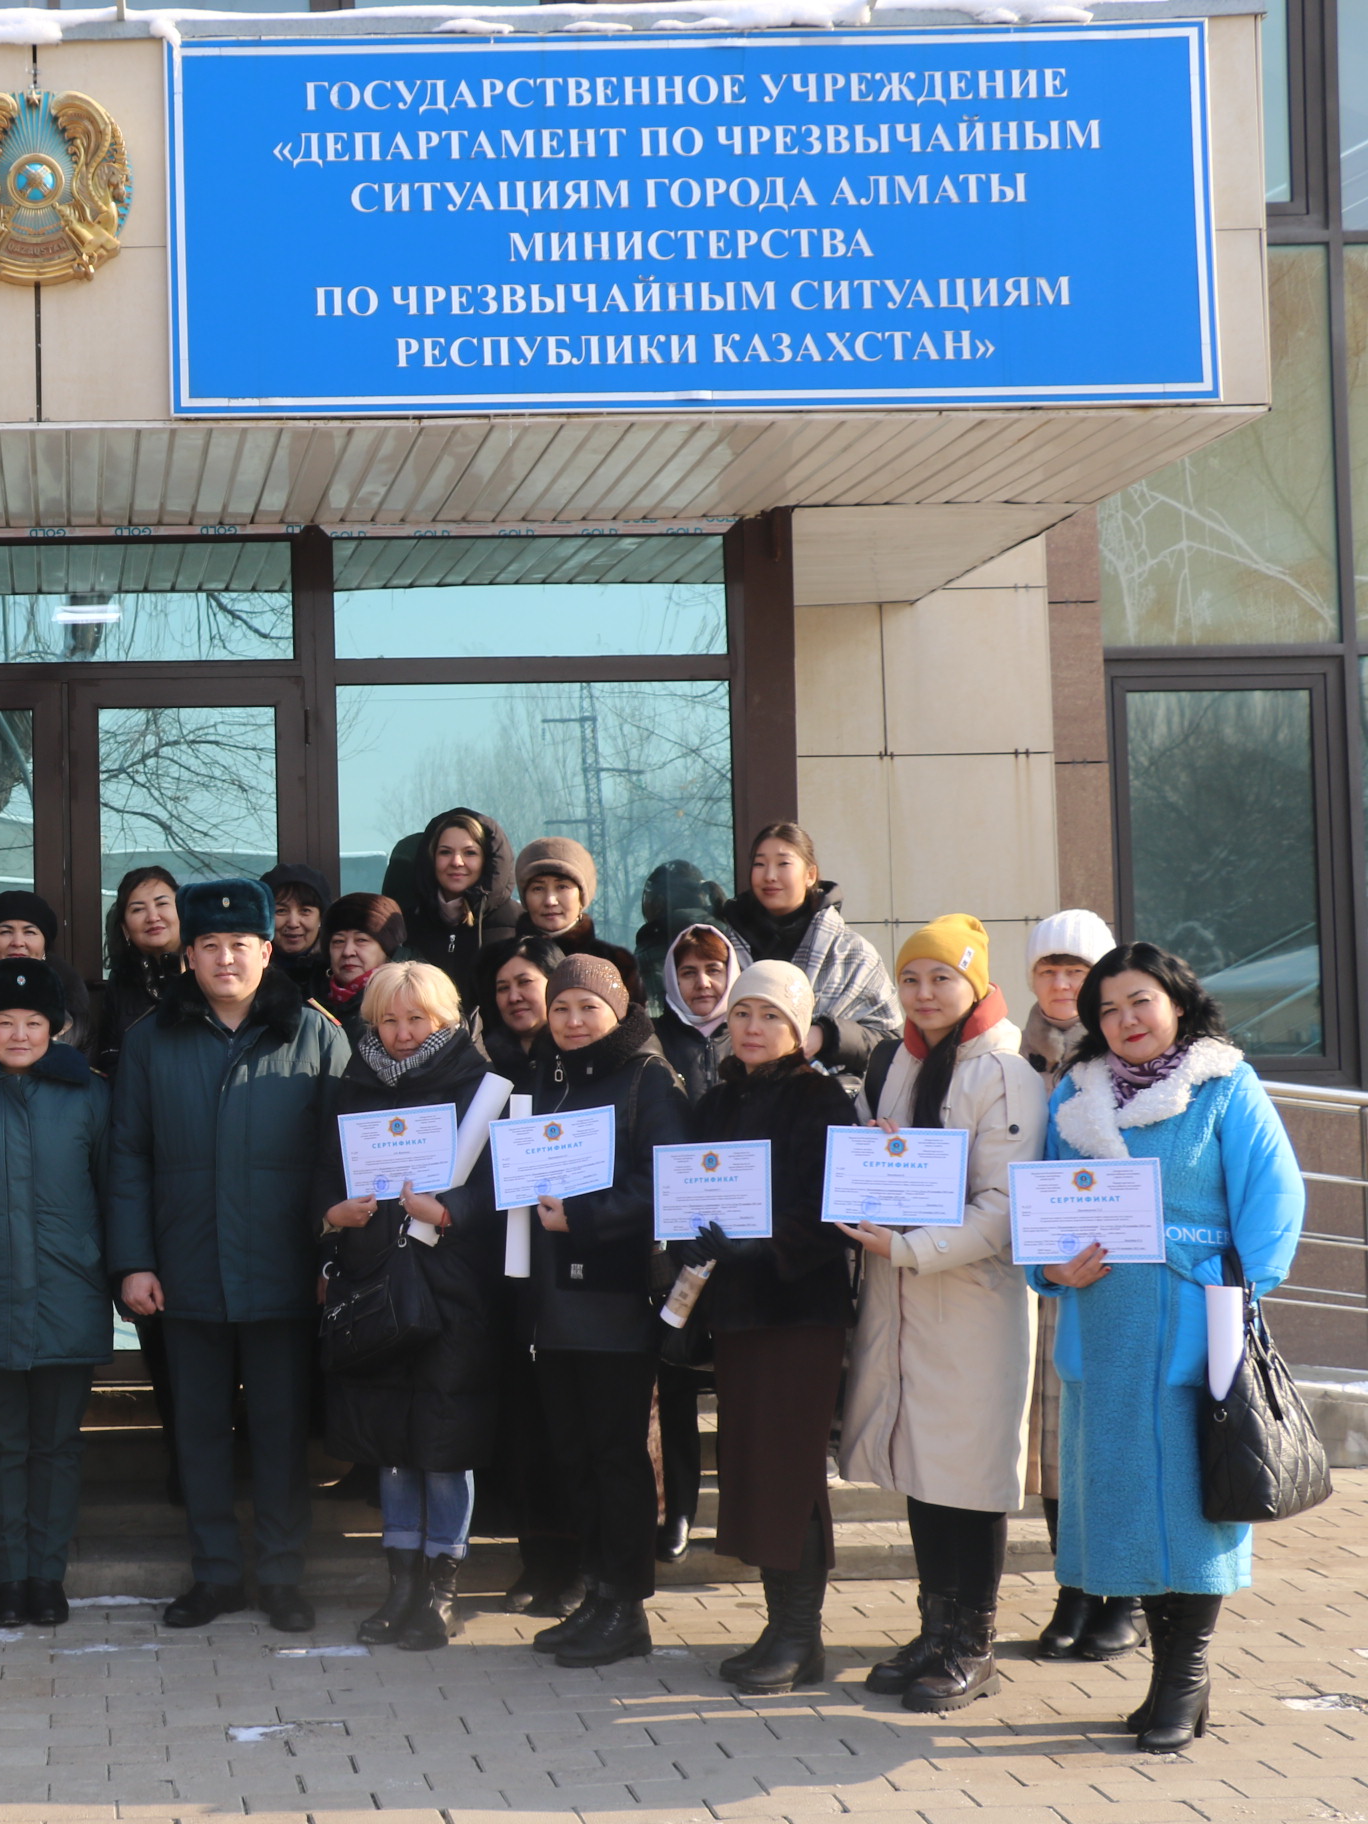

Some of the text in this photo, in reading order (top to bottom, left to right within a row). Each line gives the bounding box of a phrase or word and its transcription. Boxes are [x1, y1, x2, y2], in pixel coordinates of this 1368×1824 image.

[305, 67, 1069, 115] ГОСУДАРСТВЕННОЕ УЧРЕЖДЕНИЕ
[272, 114, 1101, 169] «ДЕПАРТАМЕНТ ПО ЧРЕЗВЫЧАЙНЫМ
[350, 172, 1027, 217] СИТУАЦИЯМ ГОРОДА АЛМАТЫ
[508, 227, 875, 262] МИНИСТЕРСТВА
[315, 274, 1071, 317] ПО ЧРЕЗВЫЧАЙНЫМ СИТУАЦИЯМ
[396, 330, 996, 368] РЕСПУБЛИКИ КАЗАХСТАН»
[29, 528, 66, 538] GOLD
[114, 527, 152, 536] GOLD
[200, 525, 237, 535] GOLD
[372, 1138, 427, 1149] СЕРТИФИКАТ
[525, 1141, 583, 1155] СЕРТИФИКАТ
[863, 1160, 929, 1169] СЕРТИФИКАТ
[684, 1175, 739, 1185] СЕРТИФИКАТ
[1049, 1195, 1121, 1204] СЕРТИФИКАТ
[1165, 1226, 1231, 1245] ONCLER
